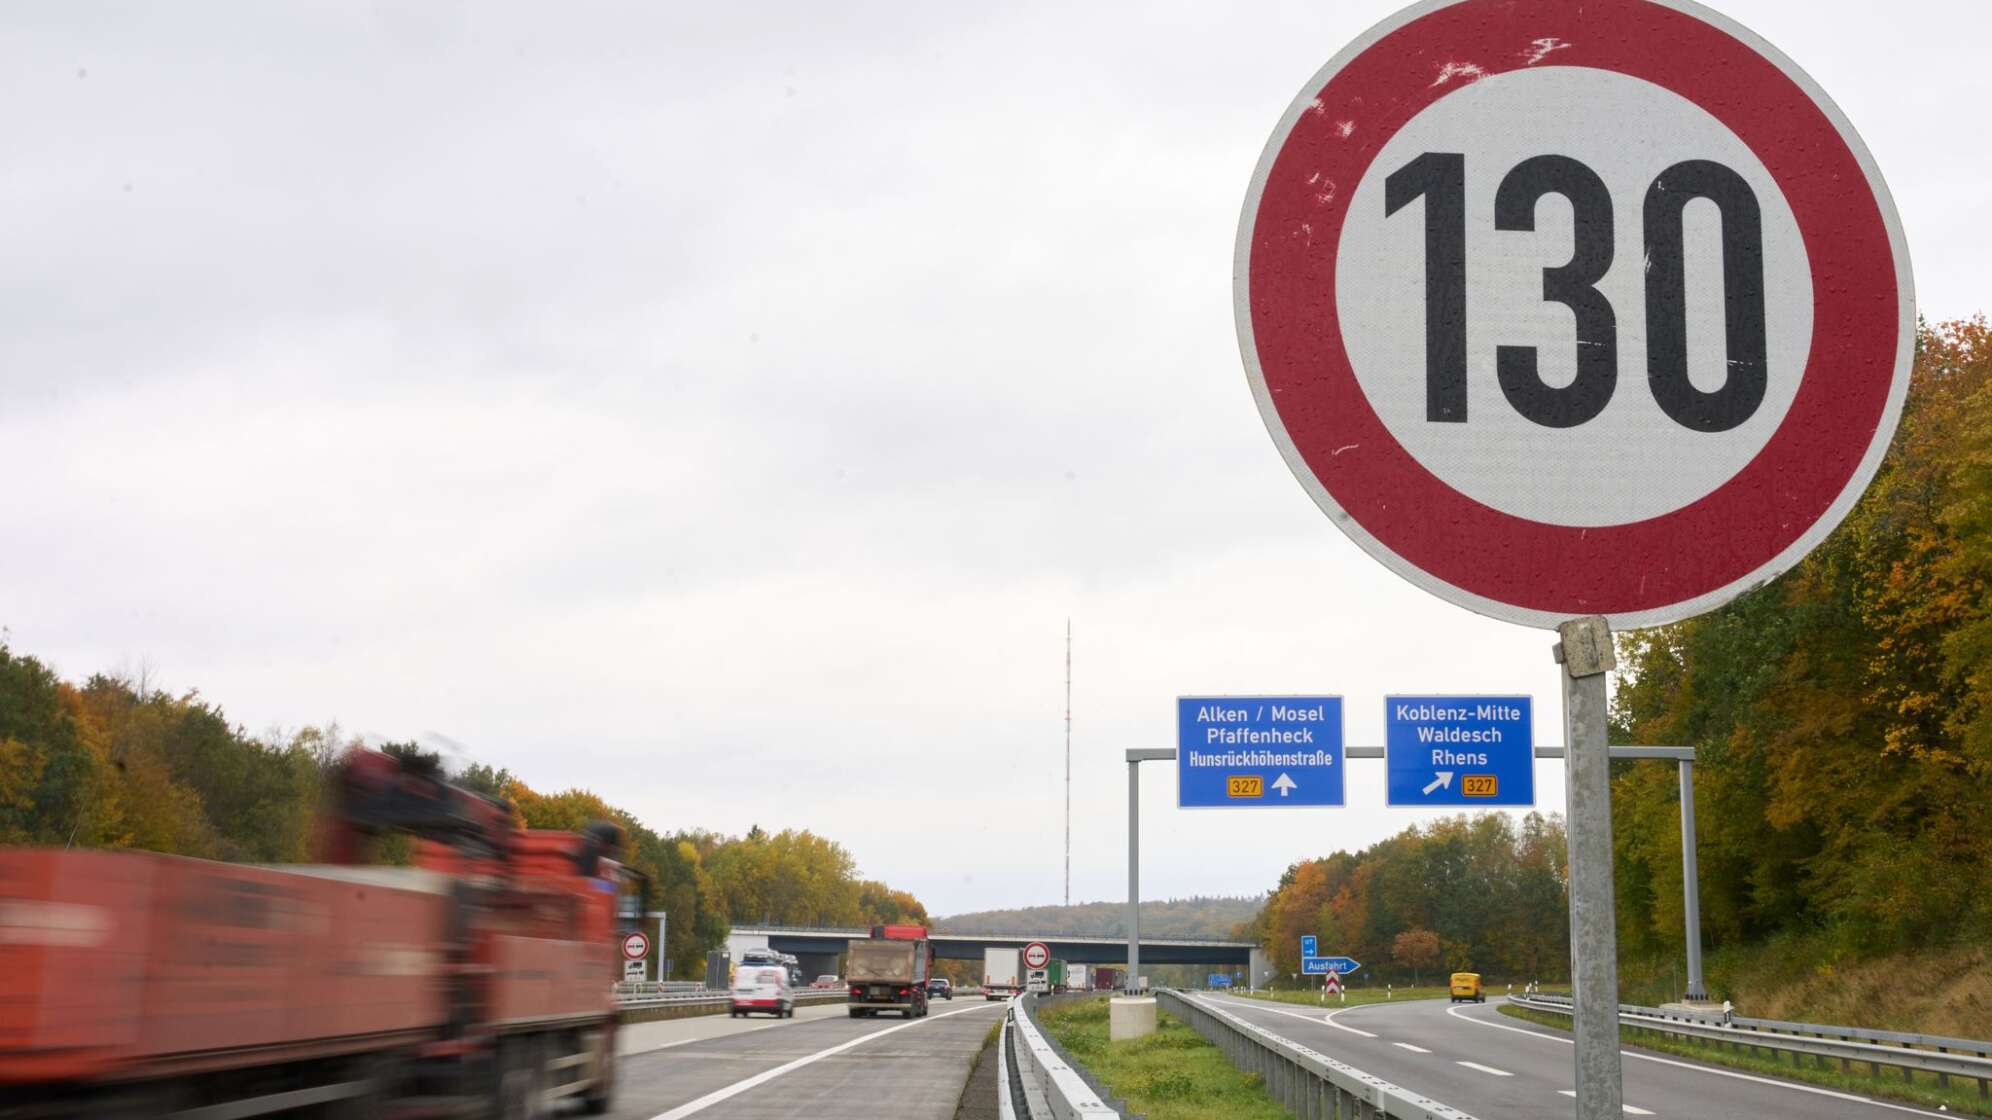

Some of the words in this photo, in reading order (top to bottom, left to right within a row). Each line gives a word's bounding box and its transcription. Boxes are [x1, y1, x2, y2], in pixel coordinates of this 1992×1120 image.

[1385, 152, 1768, 433] 130
[1197, 705, 1248, 722] Alken
[1256, 705, 1264, 722] /
[1271, 705, 1325, 722] Mosel
[1396, 704, 1521, 721] Koblenz-Mitte
[1207, 727, 1313, 744] Pfaffenheck
[1417, 727, 1501, 743] Waldesch
[1189, 749, 1333, 767] Hunsrückhöhenstraße
[1432, 749, 1488, 765] Rhens
[1232, 780, 1259, 793] 327
[1467, 779, 1492, 792] 327
[1308, 960, 1347, 971] Ausfahrt
